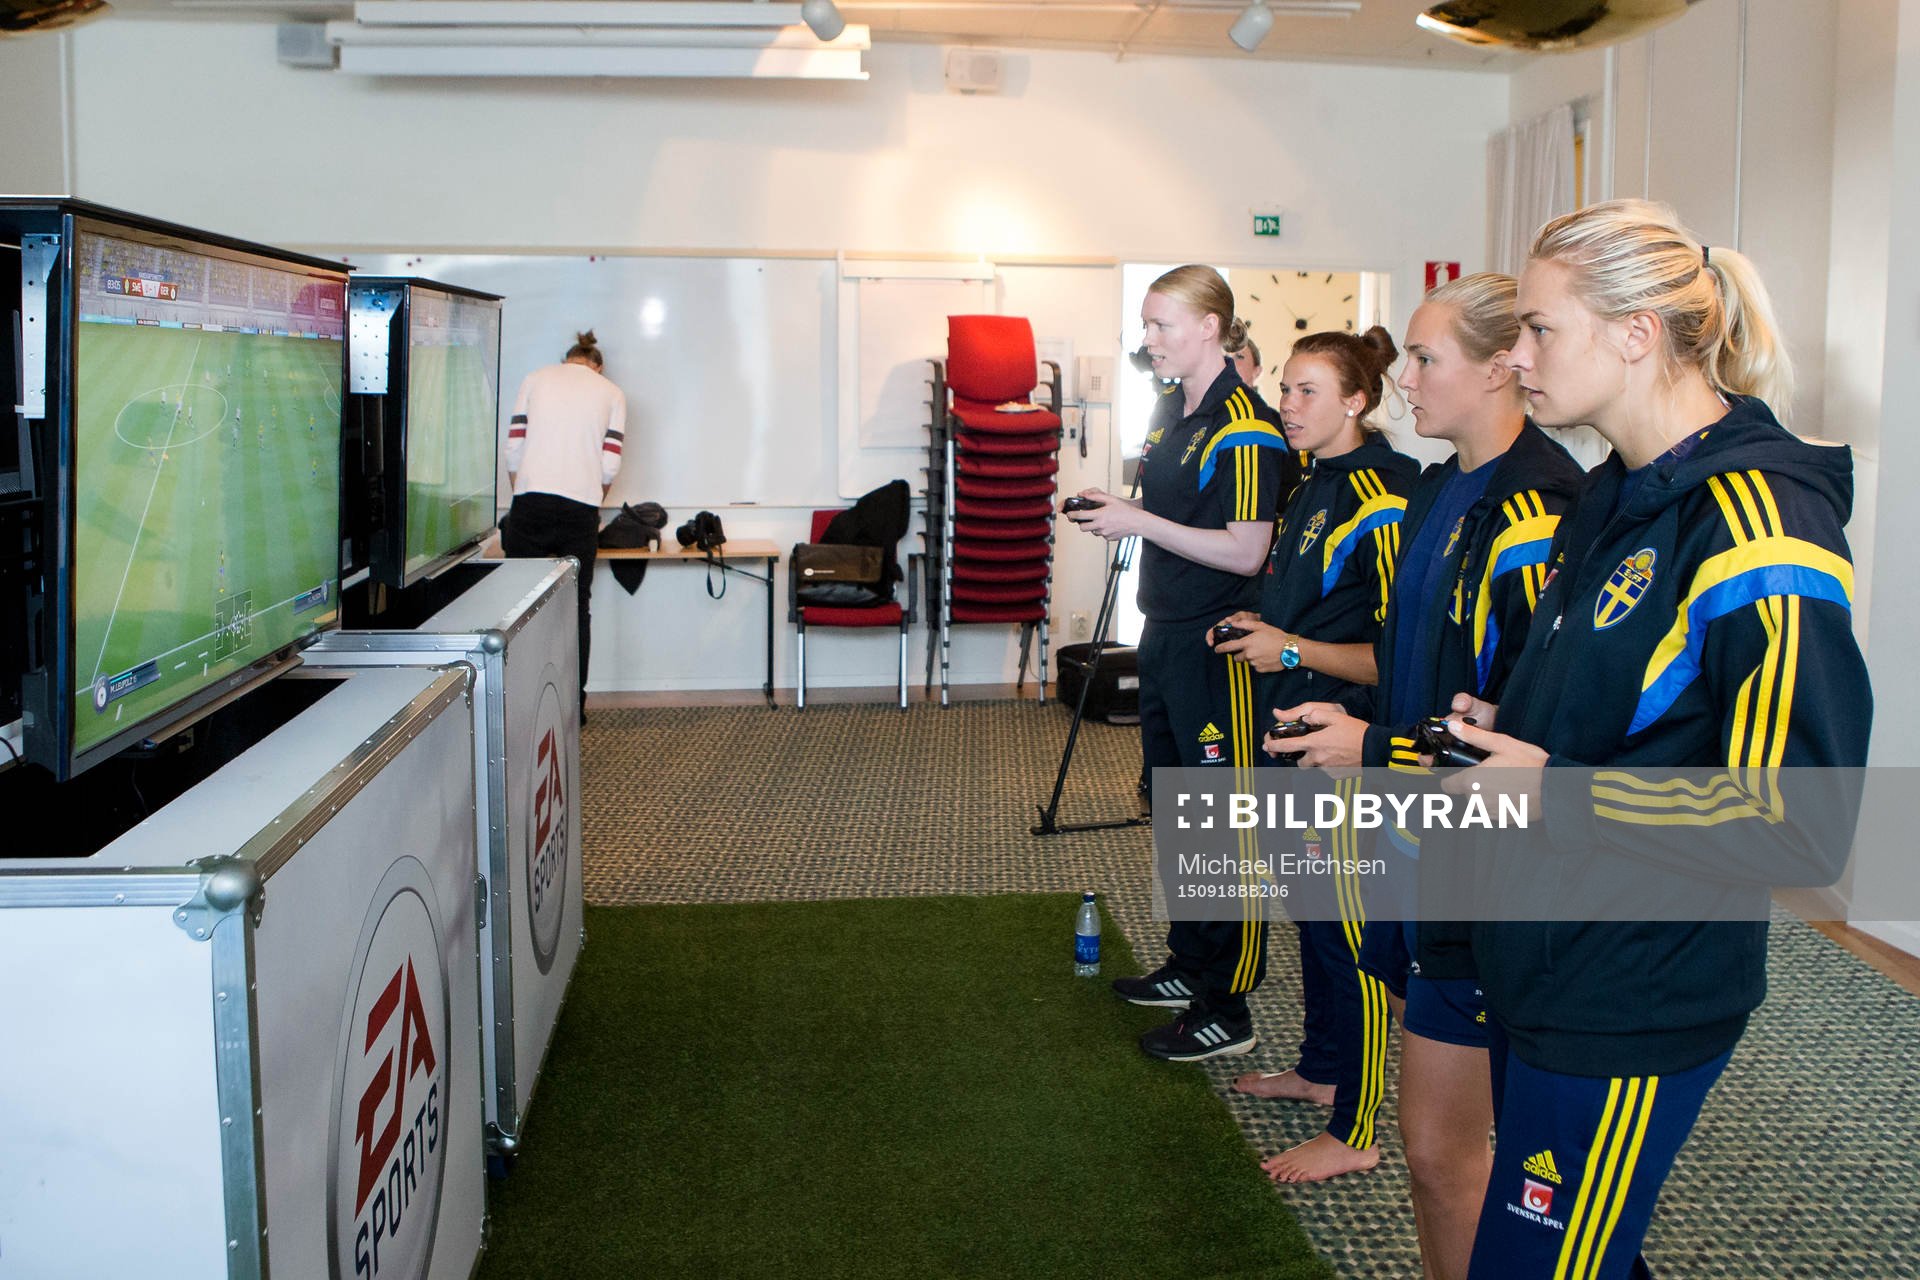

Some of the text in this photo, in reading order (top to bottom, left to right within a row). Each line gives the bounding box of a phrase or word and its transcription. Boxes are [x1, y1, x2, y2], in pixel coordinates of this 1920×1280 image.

[1198, 732, 1225, 743] adidas
[534, 725, 563, 861] EA
[534, 811, 565, 914] SPORTS
[354, 952, 436, 1222] EA
[354, 1083, 438, 1280] SPORTS
[1506, 1202, 1565, 1231] SVENSKA SPEL
[1522, 1160, 1563, 1185] adidas
